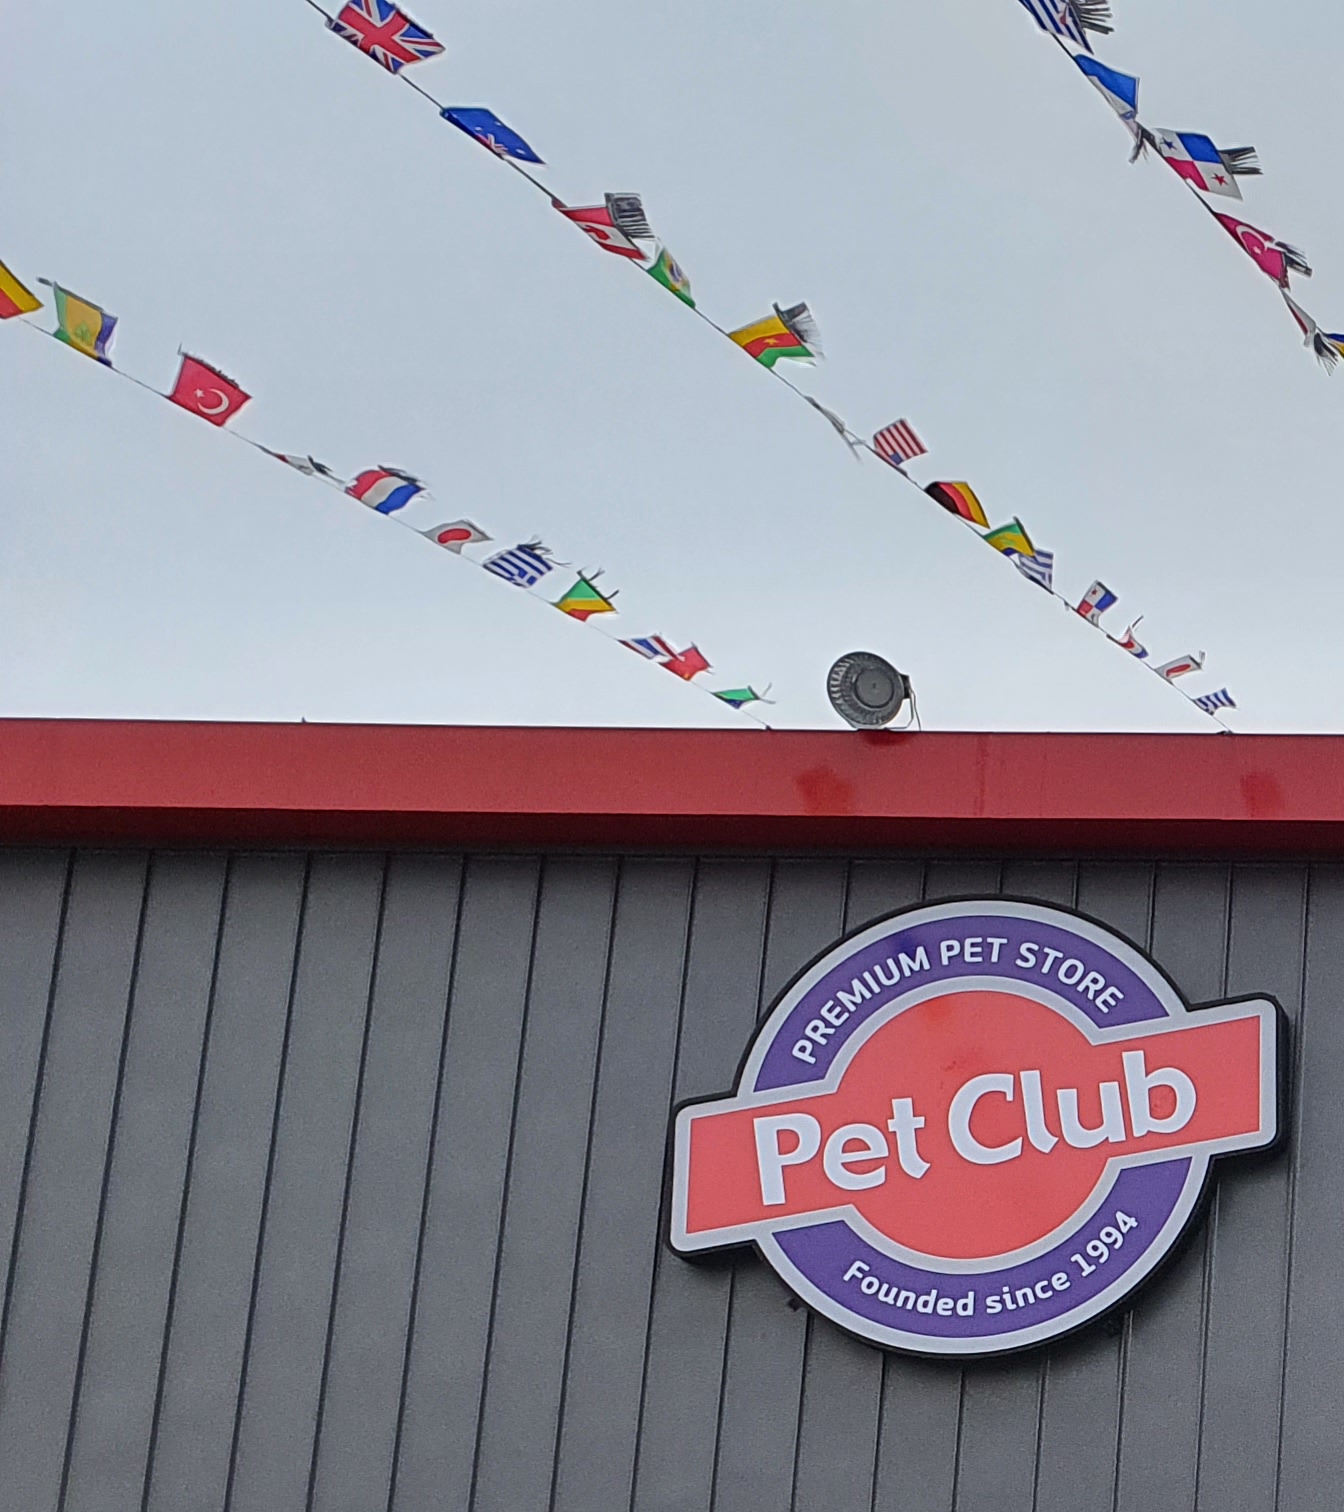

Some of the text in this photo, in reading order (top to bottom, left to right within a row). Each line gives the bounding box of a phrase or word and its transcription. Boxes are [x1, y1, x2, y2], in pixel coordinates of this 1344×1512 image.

[792, 937, 1123, 1064] PREMIUM PET STORE
[753, 1051, 1197, 1206] Pet Club
[843, 1209, 1138, 1316] Founded since 1994
